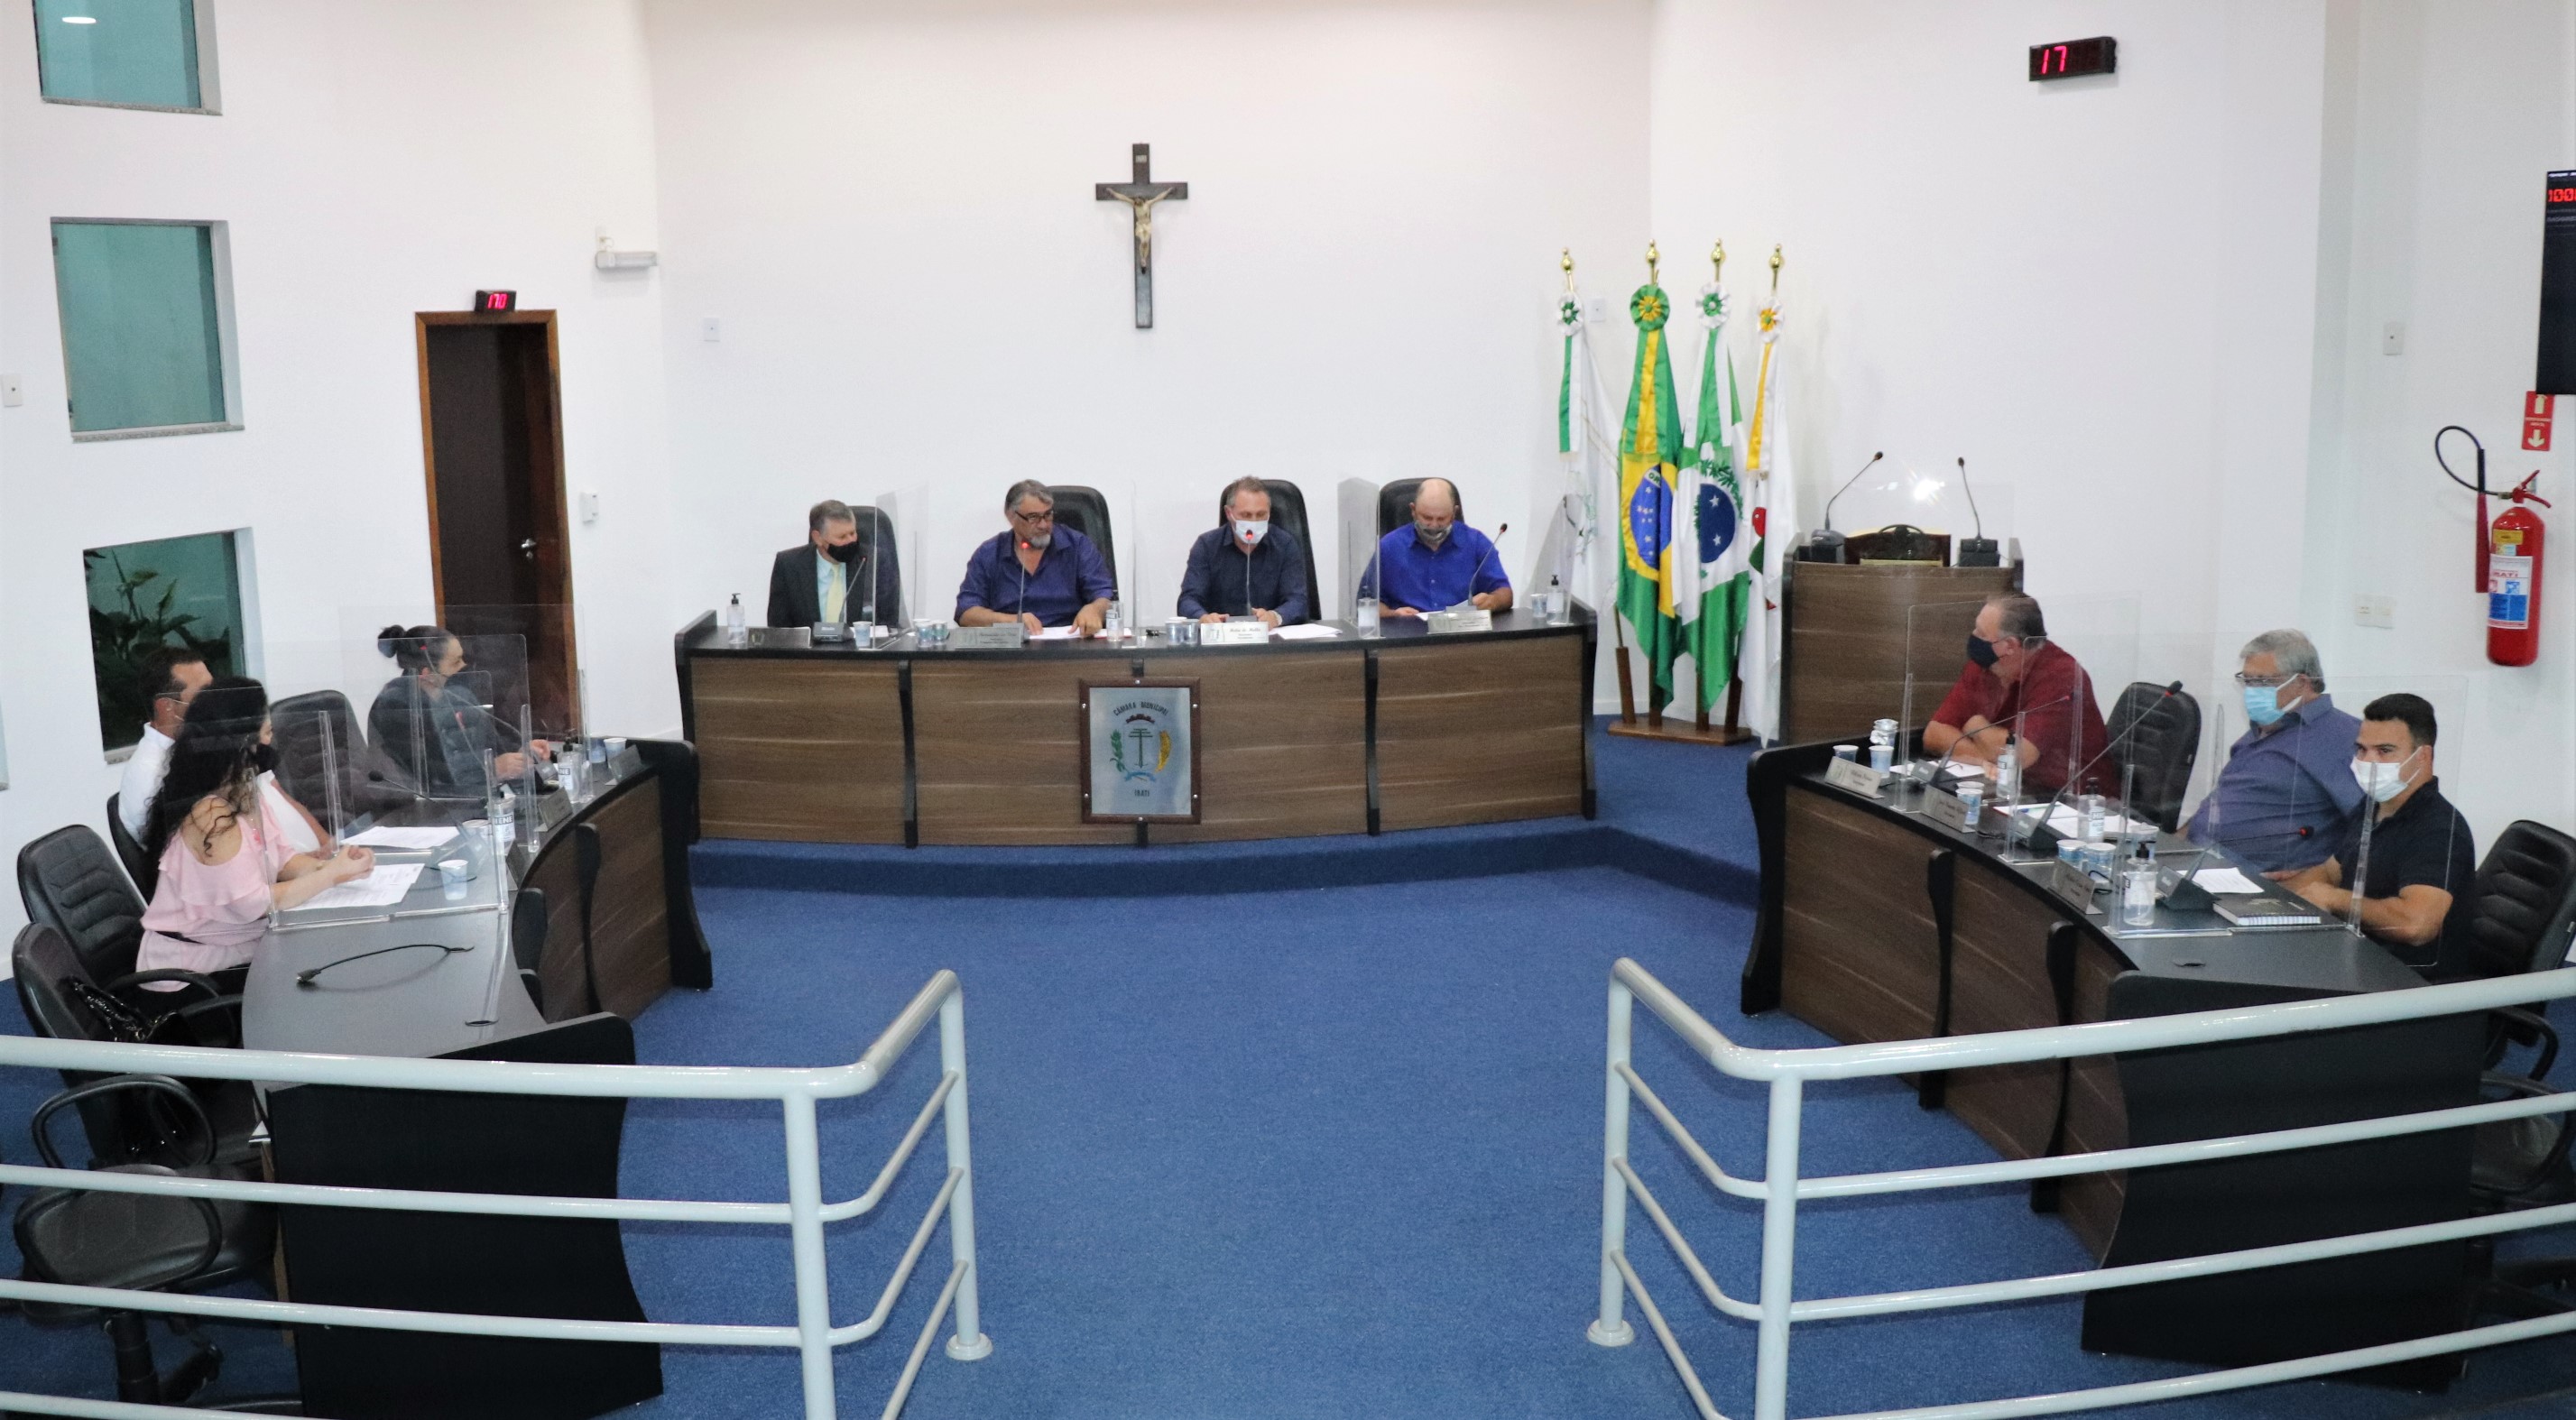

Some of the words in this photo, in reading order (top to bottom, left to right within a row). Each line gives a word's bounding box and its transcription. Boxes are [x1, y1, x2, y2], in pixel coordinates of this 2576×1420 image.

[2040, 45, 2068, 74] 17
[2547, 188, 2576, 202] 100
[1140, 701, 1169, 716] MUNICIPAL
[1134, 789, 1150, 798] IRATI
